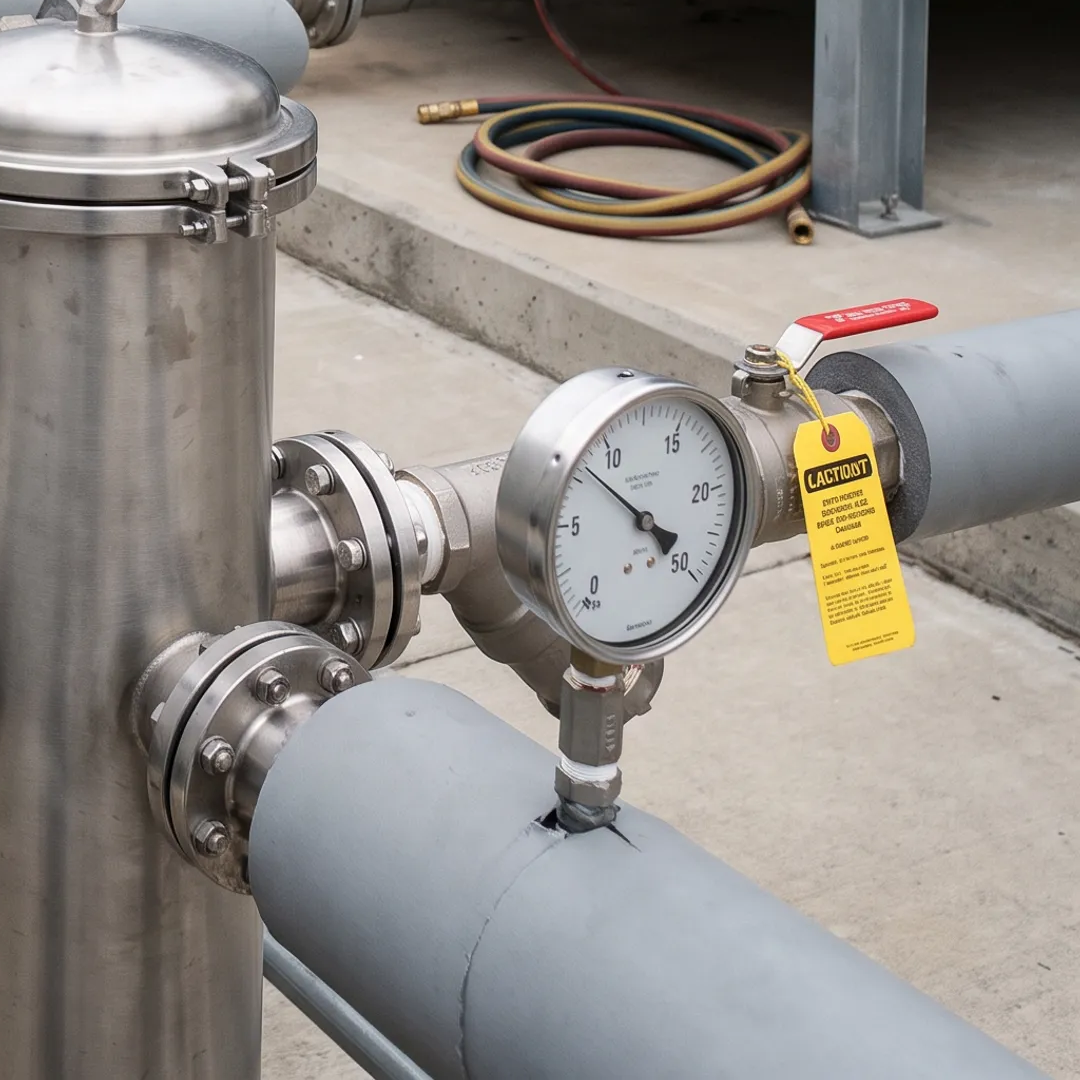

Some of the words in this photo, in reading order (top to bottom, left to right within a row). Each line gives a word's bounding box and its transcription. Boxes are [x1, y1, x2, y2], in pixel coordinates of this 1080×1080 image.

[665, 433, 680, 455] 15
[605, 447, 621, 470] 10
[691, 481, 709, 504] 20
[571, 516, 580, 537] 5
[671, 551, 689, 574] 50
[590, 575, 599, 594] 0
